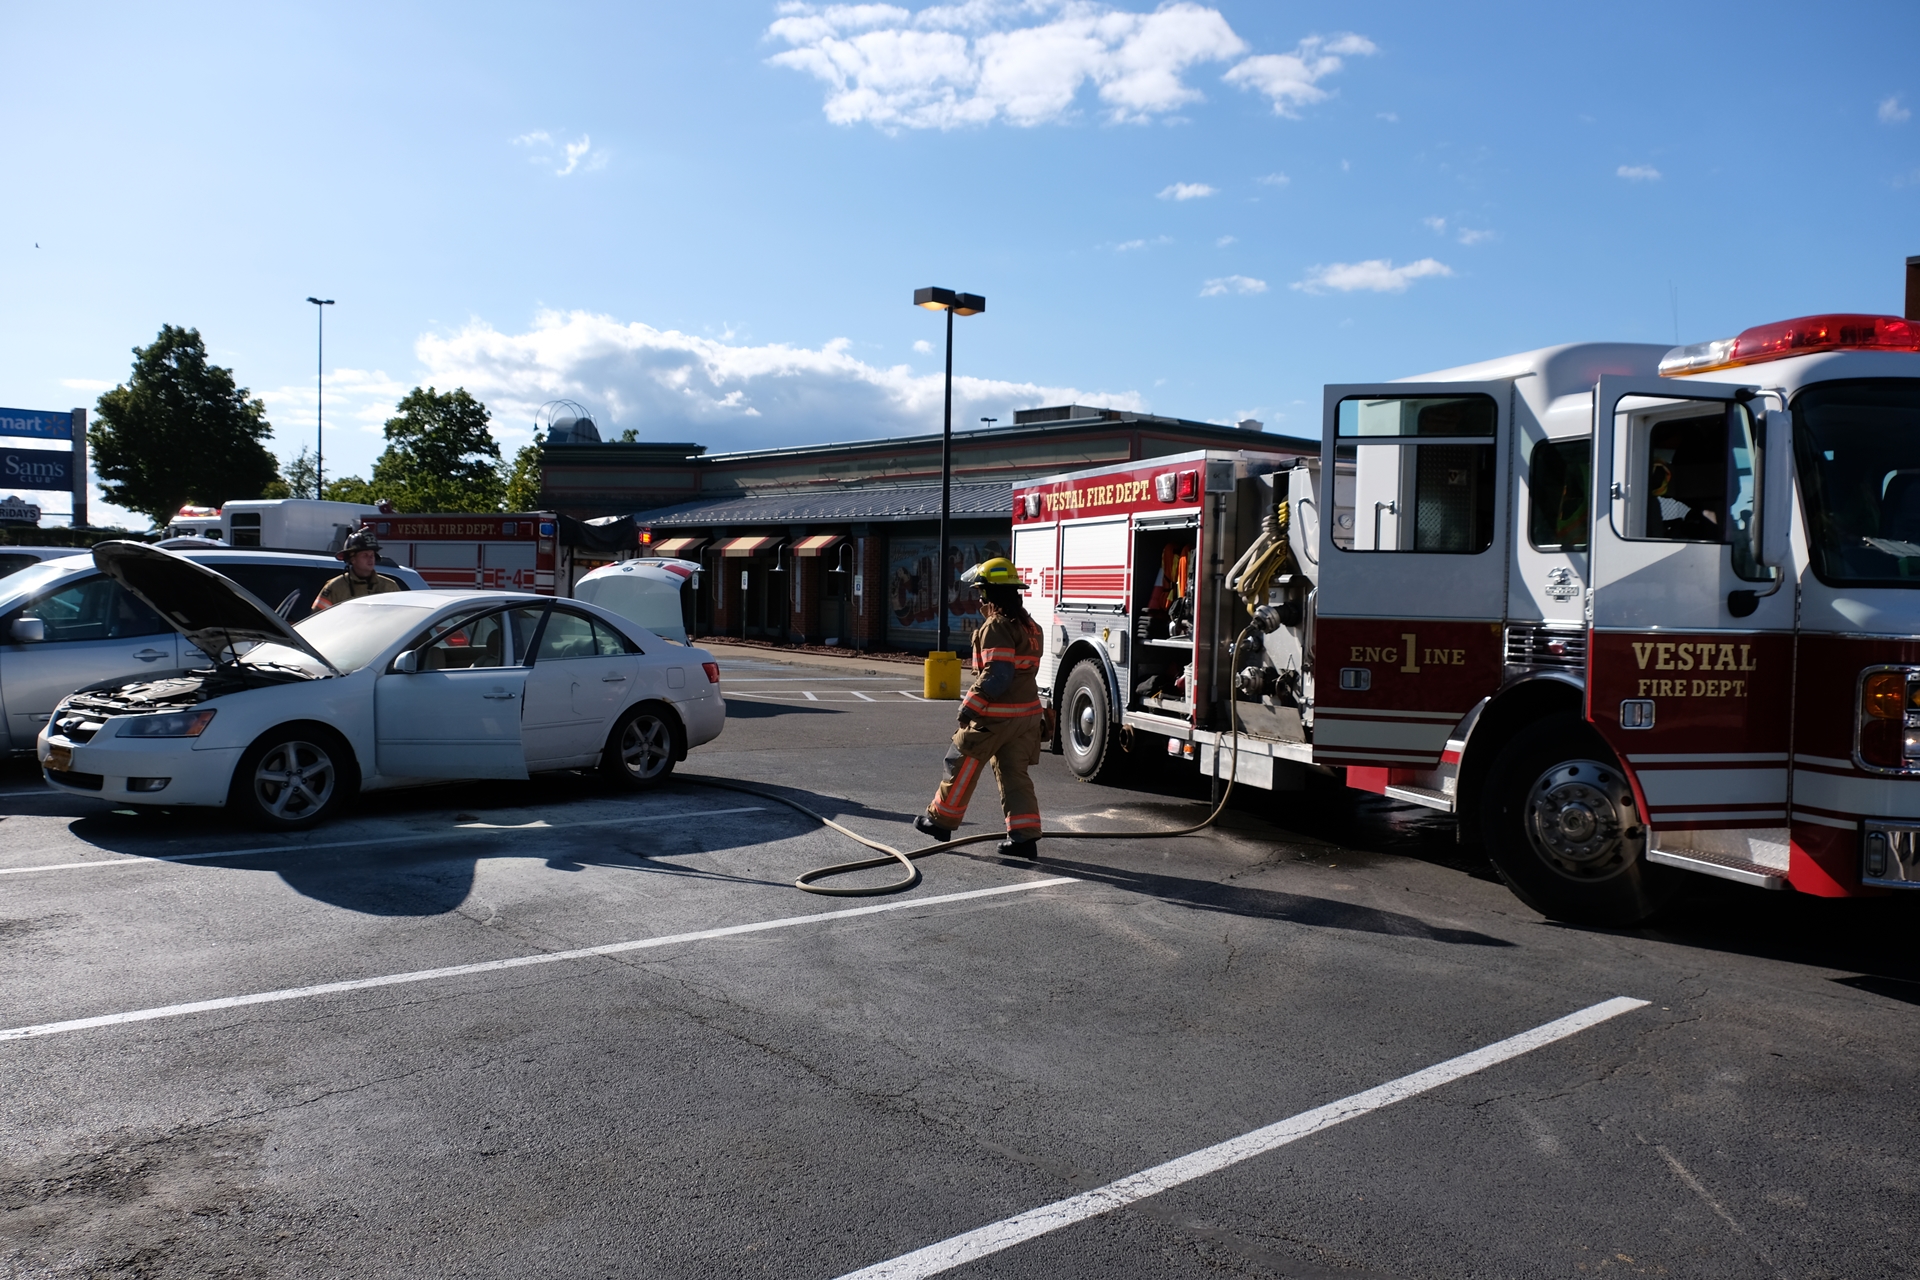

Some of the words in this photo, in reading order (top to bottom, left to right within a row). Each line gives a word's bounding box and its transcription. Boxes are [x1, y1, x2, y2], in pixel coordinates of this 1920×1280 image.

[5, 455, 64, 477] Sam's
[20, 475, 51, 483] CLUB
[1046, 490, 1085, 512] VESTAL
[1086, 484, 1115, 507] FIRE
[1115, 479, 1151, 503] DEPT.
[397, 523, 437, 535] VESTAL
[439, 523, 464, 535] FIRE
[466, 524, 497, 535] DEPT.
[494, 568, 523, 589] E-4
[1632, 642, 1757, 671] VESTAL
[1638, 679, 1687, 697] FIRE
[1691, 679, 1748, 698] DEPT.
